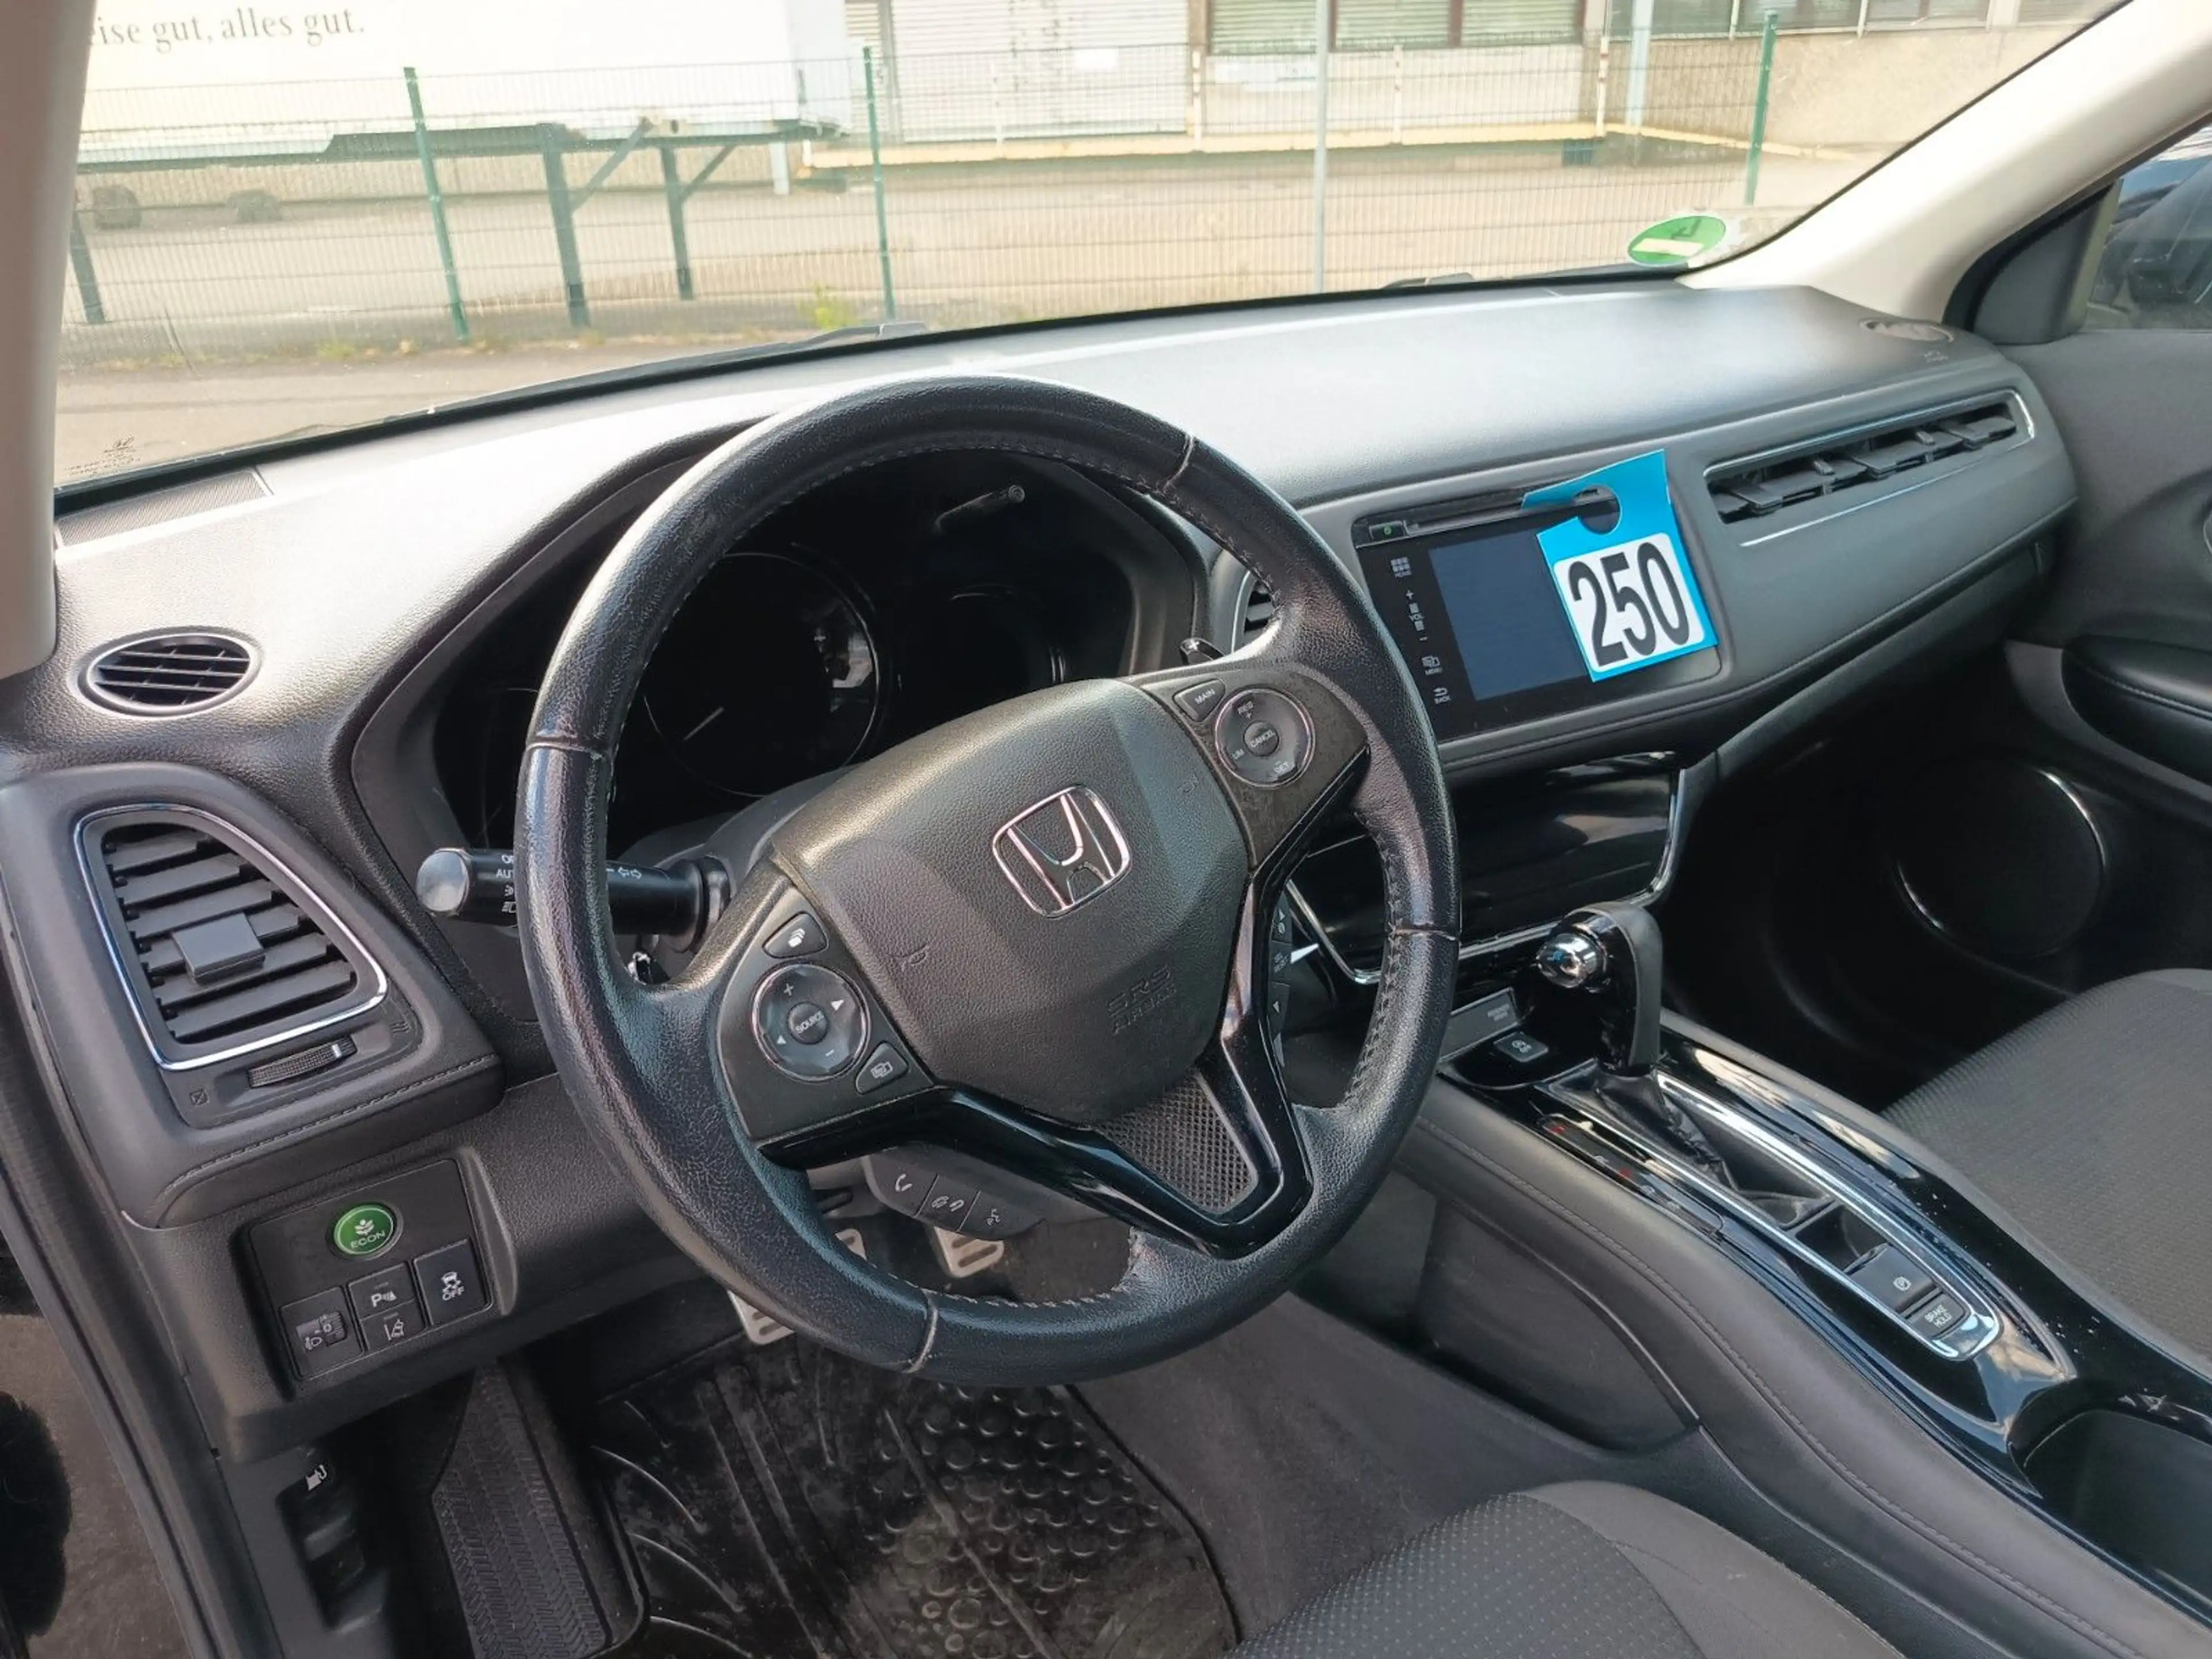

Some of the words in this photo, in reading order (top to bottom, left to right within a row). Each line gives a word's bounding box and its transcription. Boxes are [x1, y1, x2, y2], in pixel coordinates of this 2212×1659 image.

[90, 16, 141, 46] ise
[152, 16, 213, 54] gut,
[221, 7, 293, 40] alles
[304, 8, 365, 47] gut.
[1568, 541, 1690, 667] 250
[1194, 688, 1216, 704] MAIN
[794, 1010, 825, 1034] SOURCE
[350, 1230, 386, 1249] ECON
[442, 1285, 465, 1301] OFF
